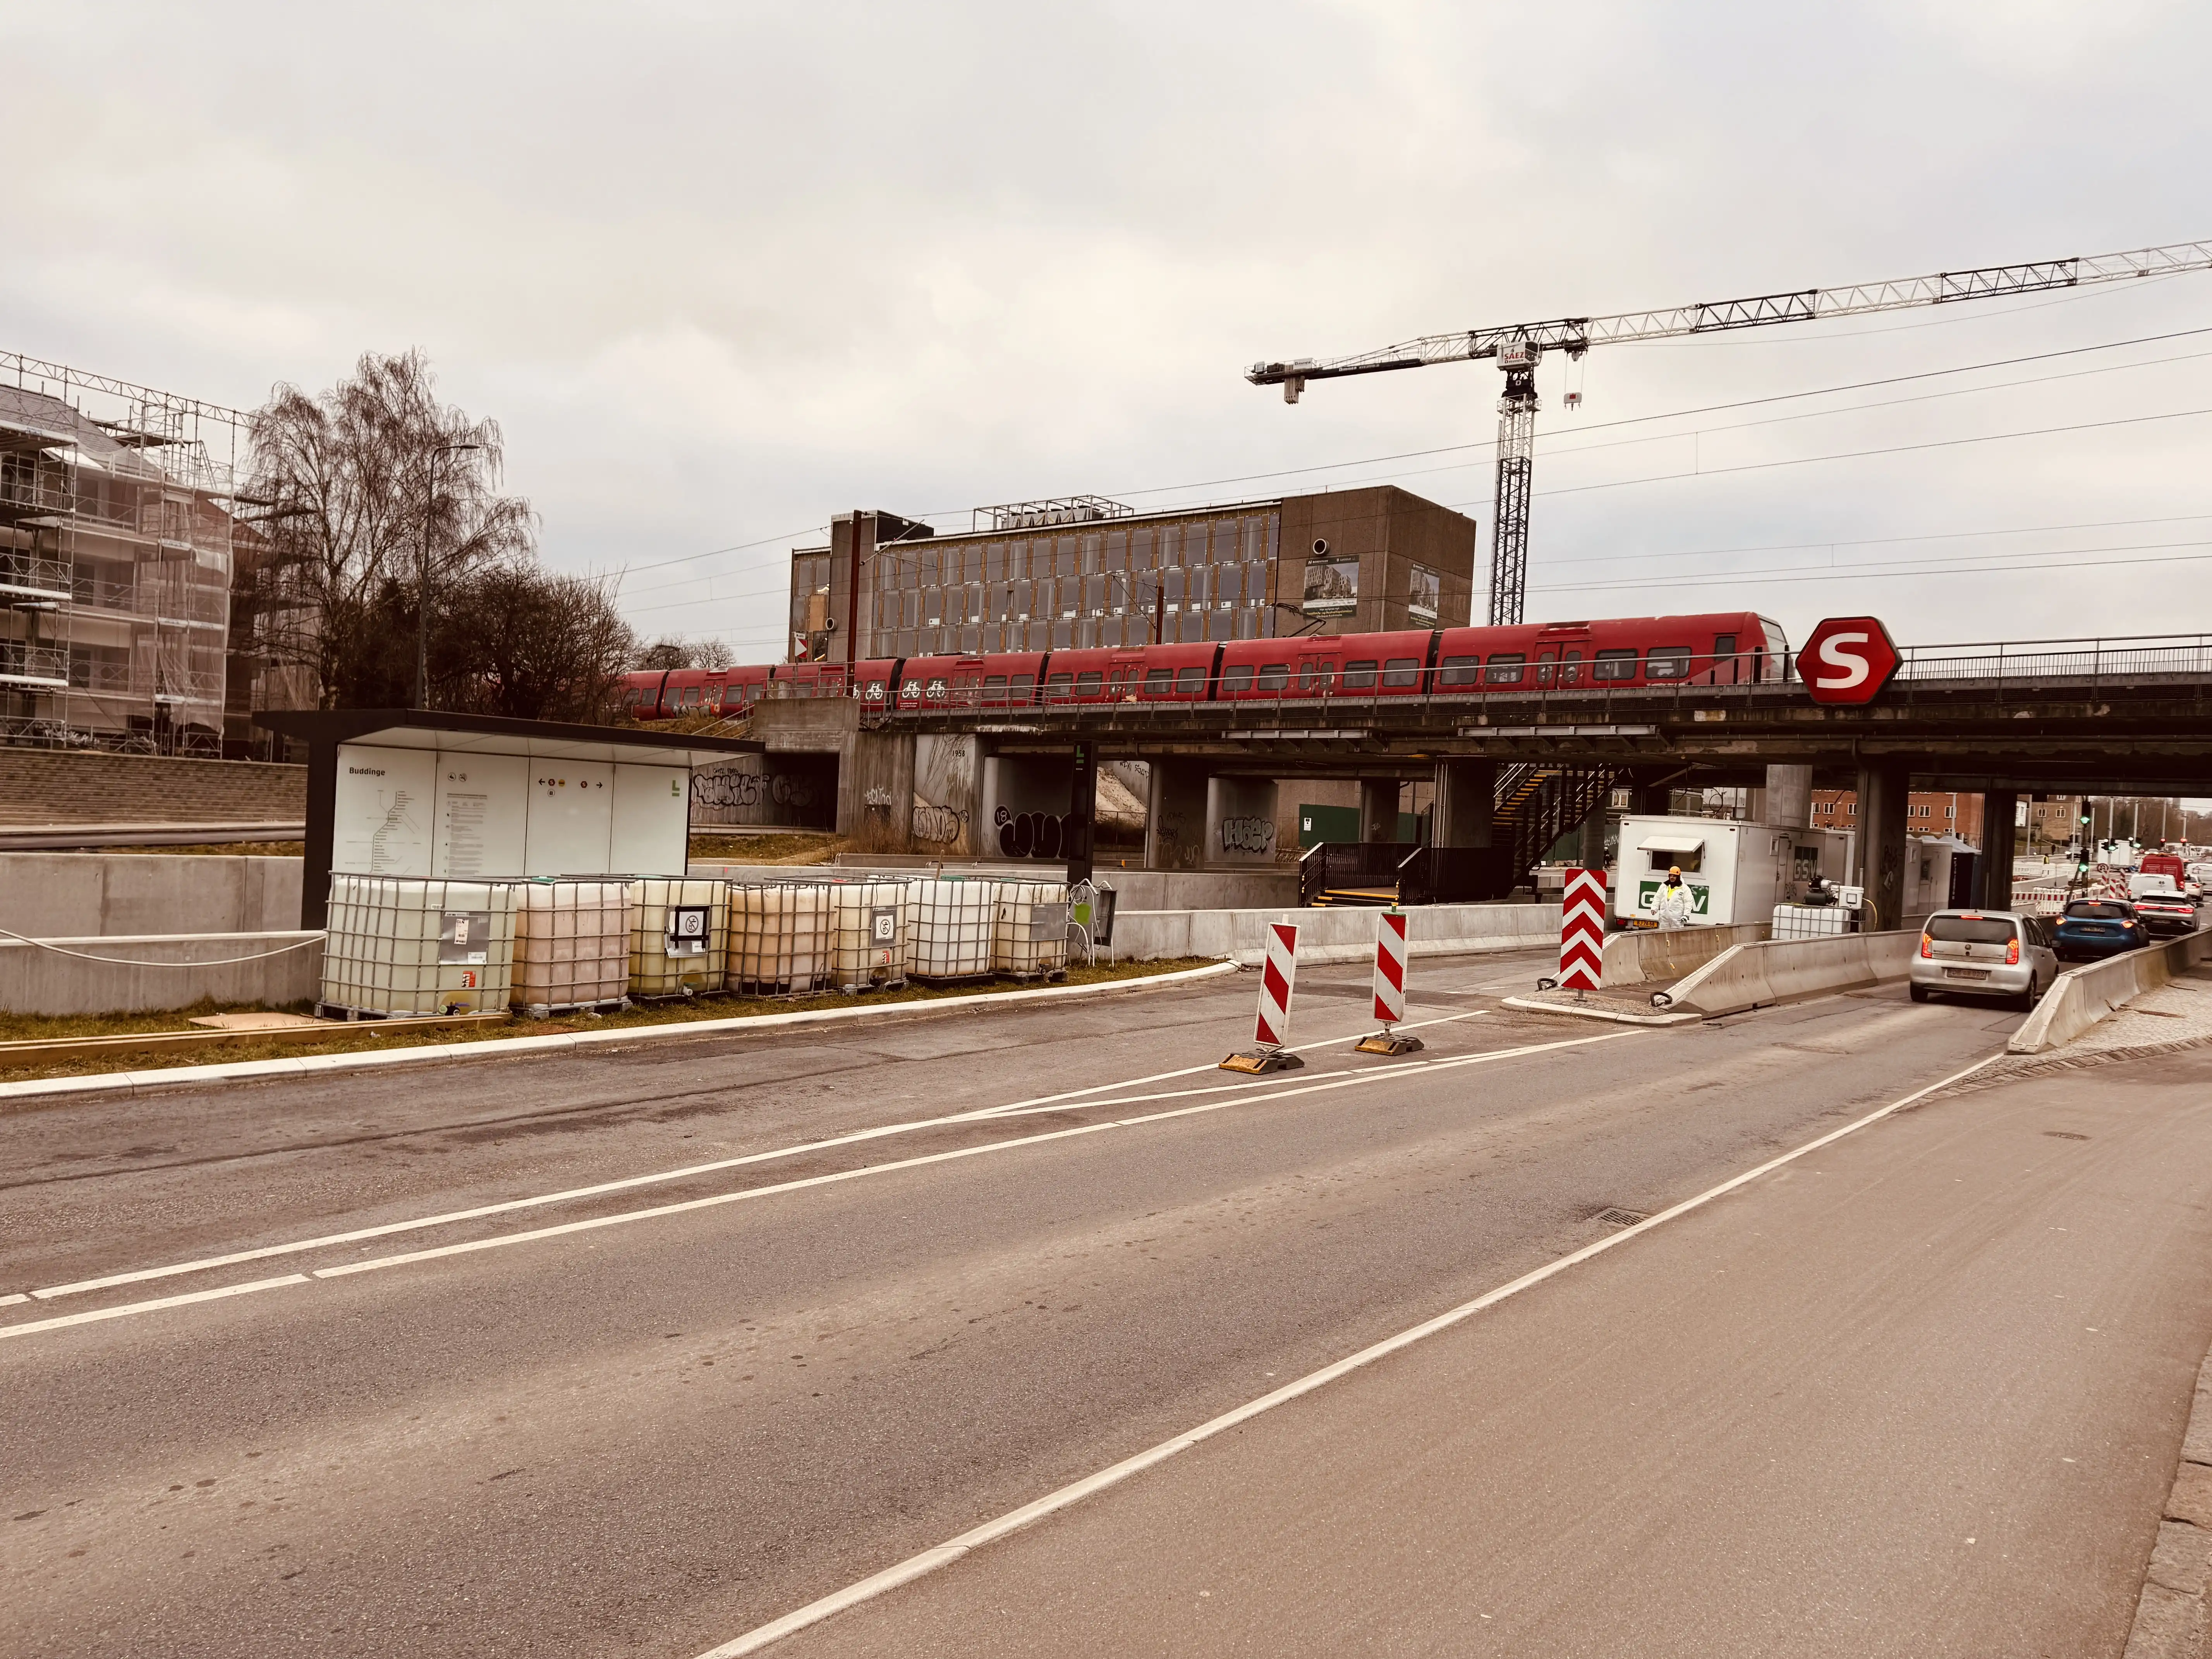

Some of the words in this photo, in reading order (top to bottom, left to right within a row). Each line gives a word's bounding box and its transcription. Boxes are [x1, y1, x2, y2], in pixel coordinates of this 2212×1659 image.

[1504, 352, 1524, 360] SAEZ
[1816, 632, 1869, 689] S
[349, 767, 385, 776] Buddinge
[997, 810, 1007, 823] 18
[1794, 859, 1817, 879] GSV
[1641, 891, 1707, 912] GV
